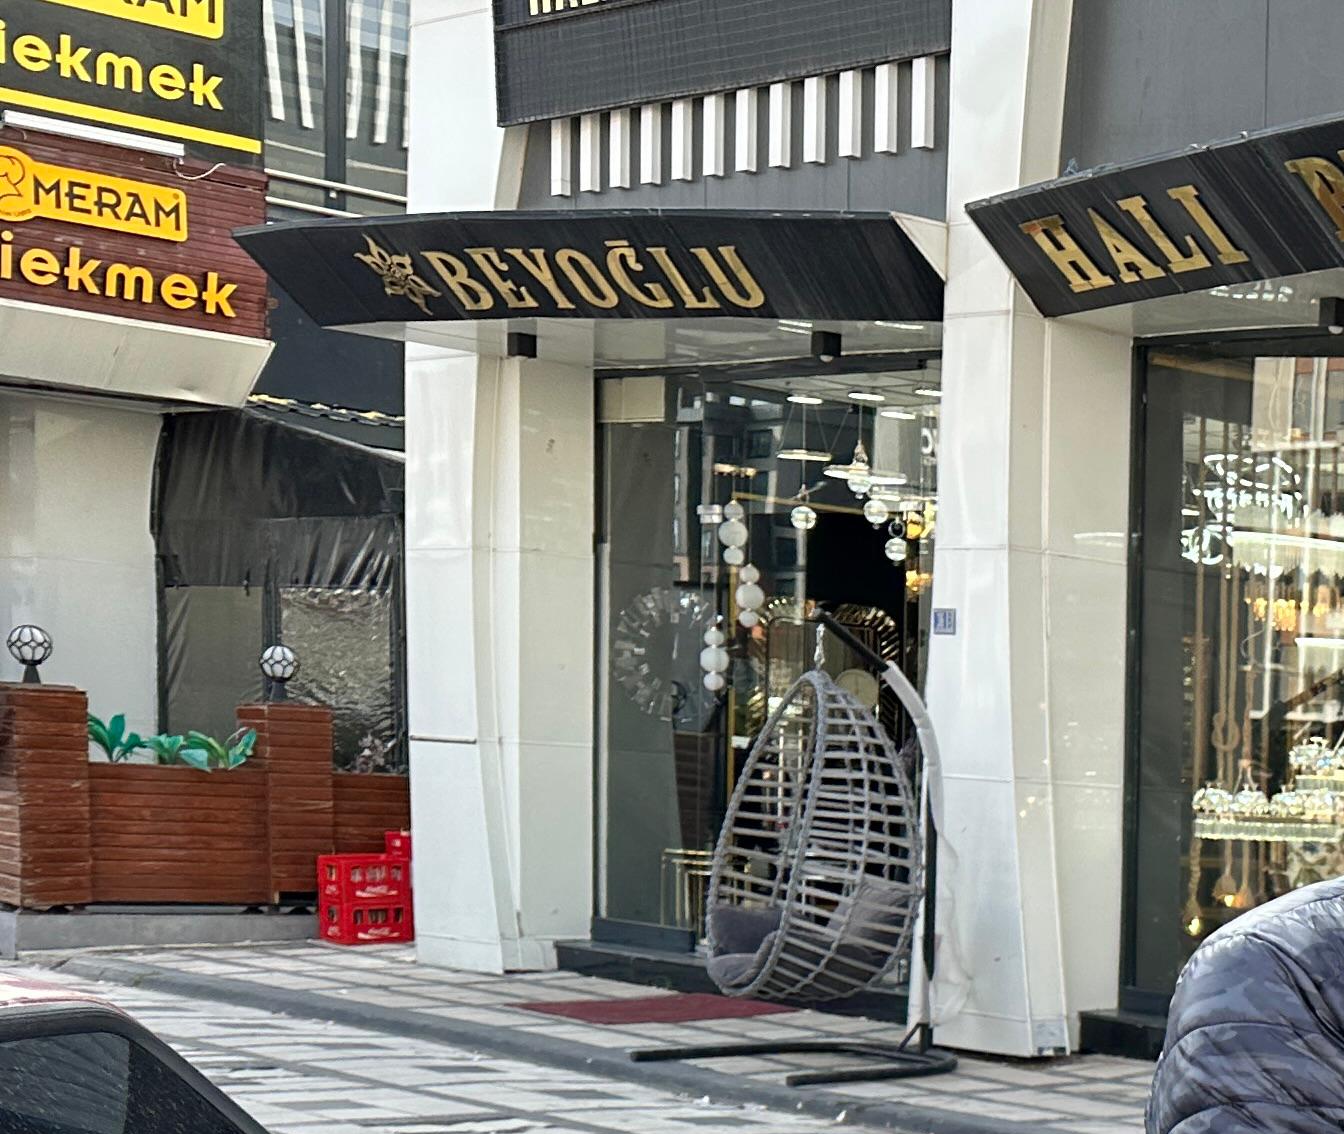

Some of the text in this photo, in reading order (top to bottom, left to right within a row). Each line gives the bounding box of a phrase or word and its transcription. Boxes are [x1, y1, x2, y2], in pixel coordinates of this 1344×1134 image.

[32, 173, 181, 231] MERAM
[1019, 184, 1250, 293] HALI
[420, 240, 766, 311] BEYOĞLU
